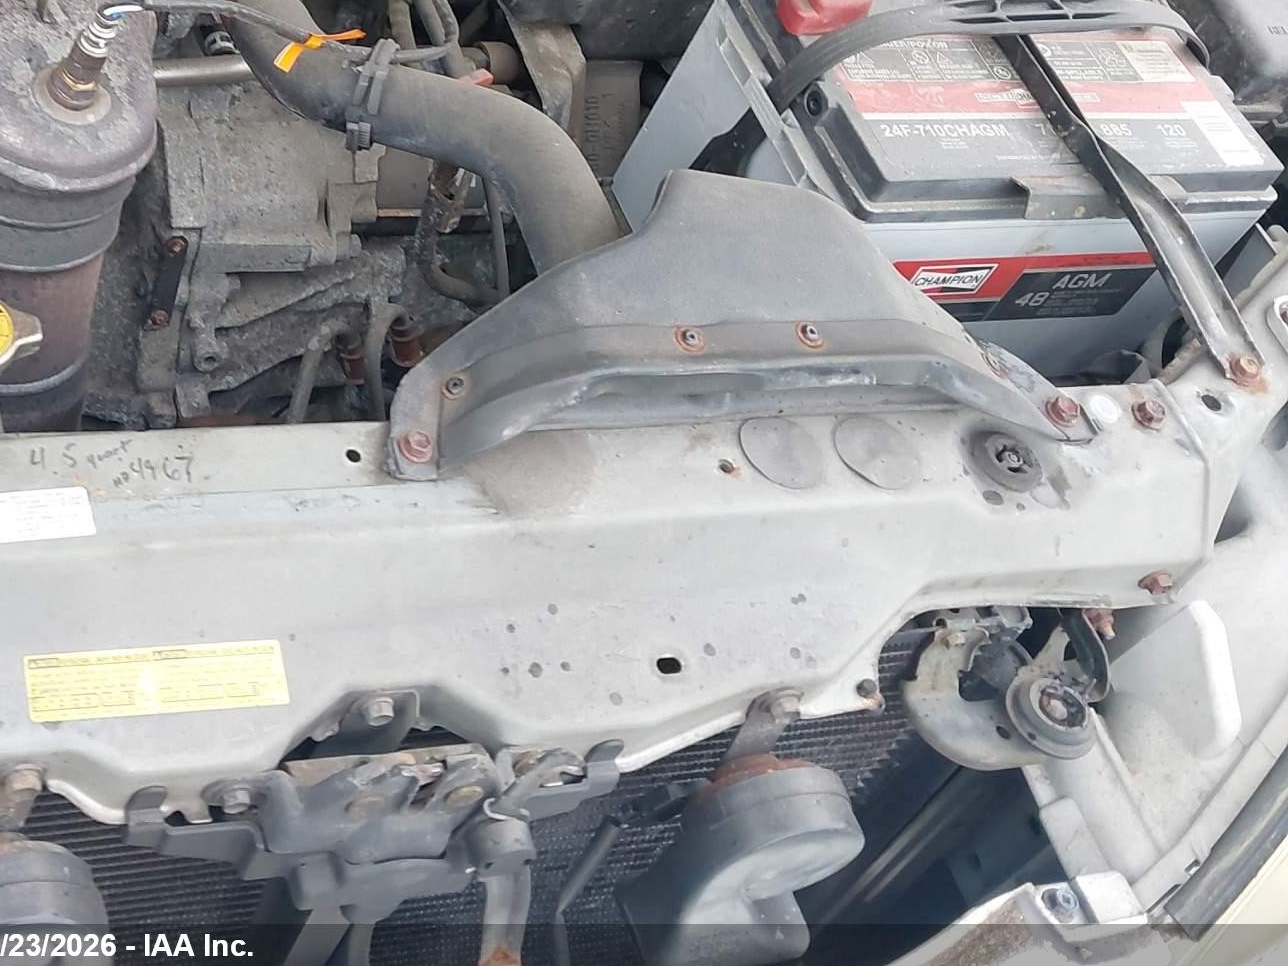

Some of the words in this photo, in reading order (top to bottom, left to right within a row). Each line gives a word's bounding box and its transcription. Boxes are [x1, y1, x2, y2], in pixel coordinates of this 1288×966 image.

[880, 123, 1009, 138] 24F-710CHAGM
[1100, 123, 1132, 136] 885
[1157, 123, 1187, 136] 120
[914, 273, 984, 287] CHAMPION
[1052, 273, 1111, 290] AGM
[1014, 291, 1050, 307] 48
